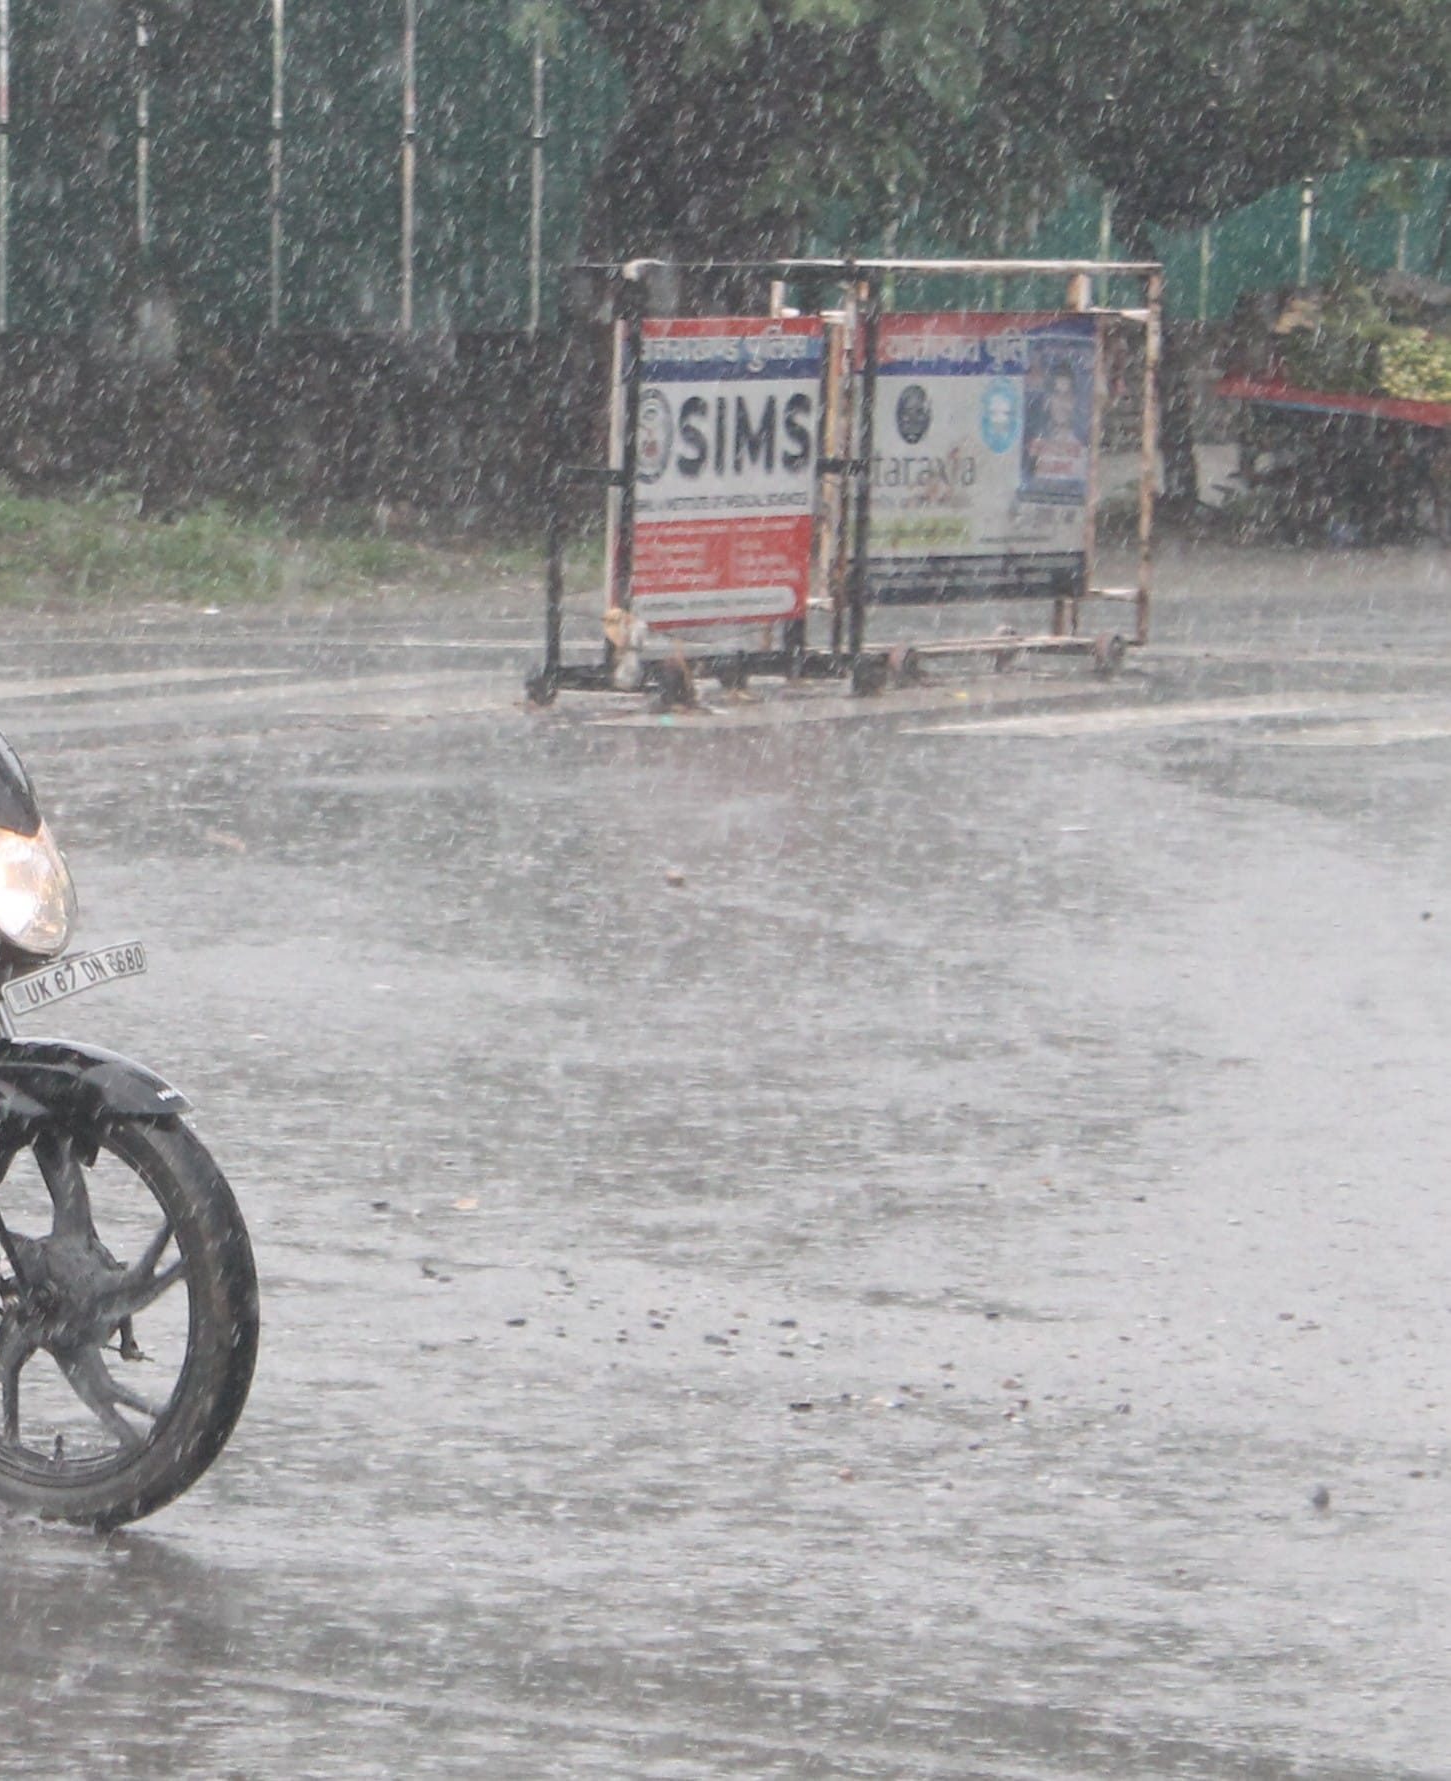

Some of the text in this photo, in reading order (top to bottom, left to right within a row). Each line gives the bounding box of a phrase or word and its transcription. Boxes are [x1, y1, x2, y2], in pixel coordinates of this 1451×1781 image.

[676, 393, 812, 479] SIMS
[868, 447, 976, 488] taraxia
[24, 976, 53, 1004] UK
